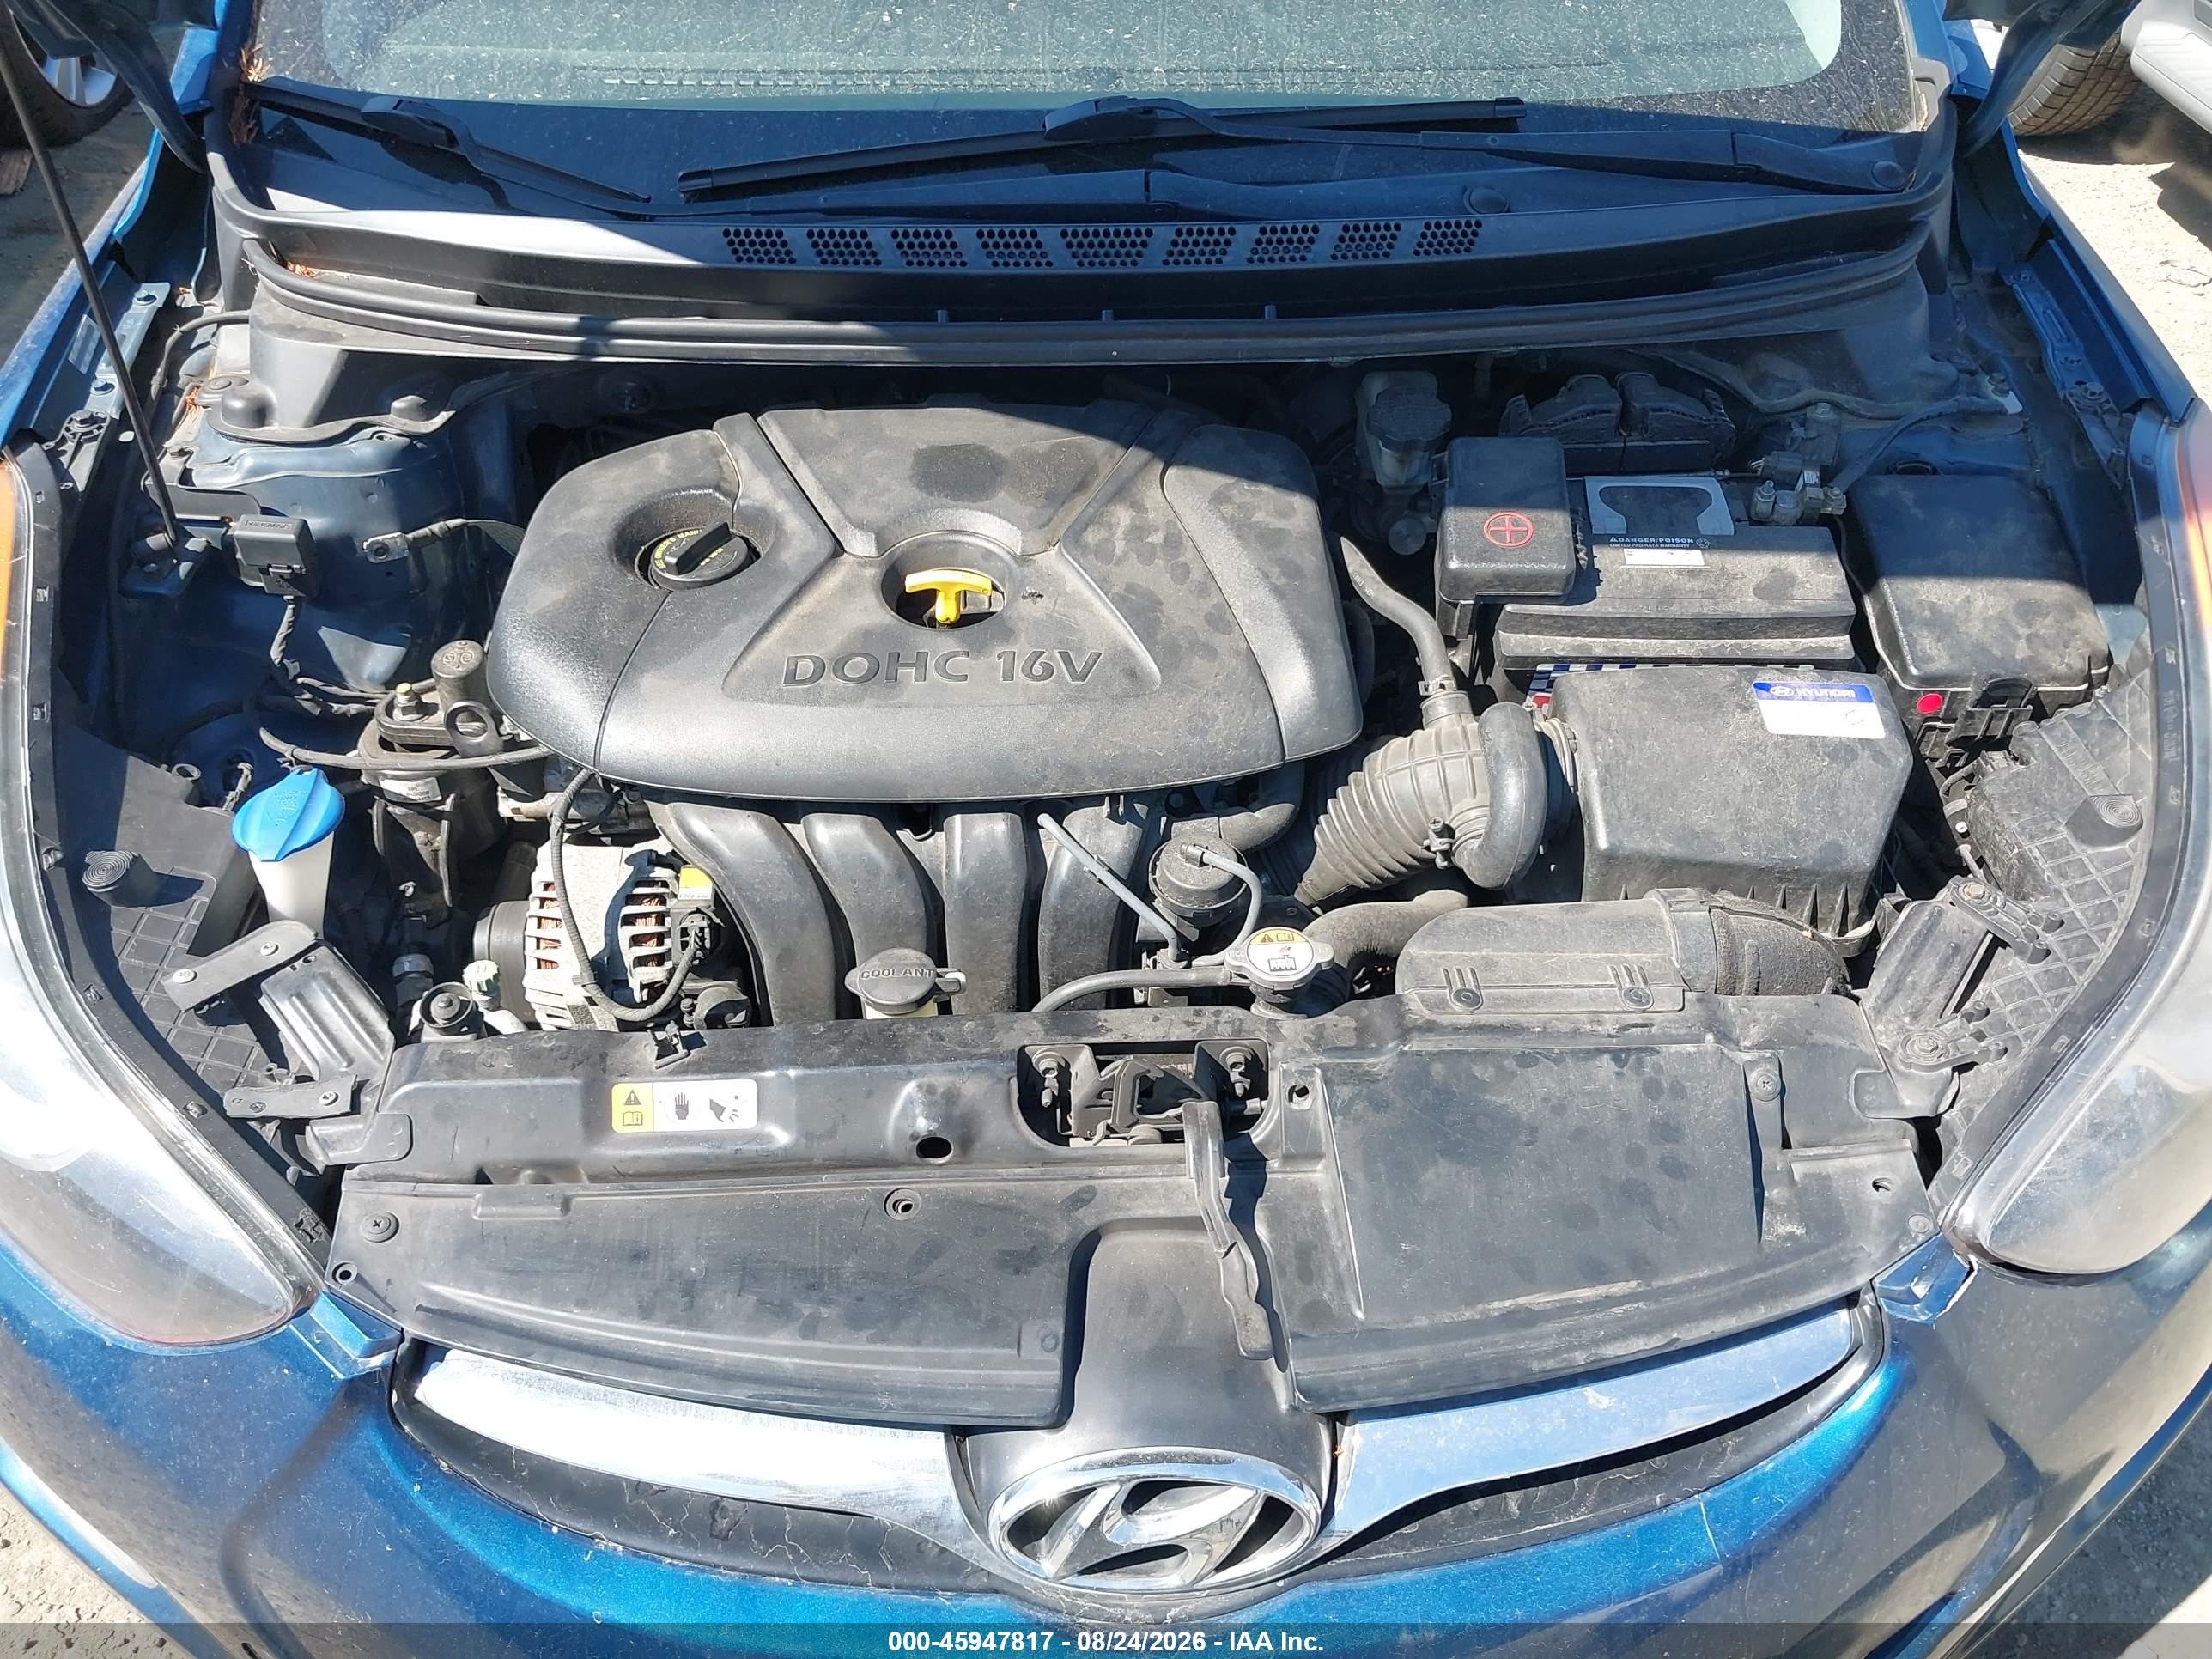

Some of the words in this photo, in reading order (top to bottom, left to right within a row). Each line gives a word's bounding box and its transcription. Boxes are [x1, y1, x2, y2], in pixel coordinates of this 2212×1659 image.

[782, 651, 970, 687] DOHC
[995, 649, 1103, 684] 16V
[1796, 688, 1856, 698] HYUNDAI
[860, 968, 935, 979] COOLANT
